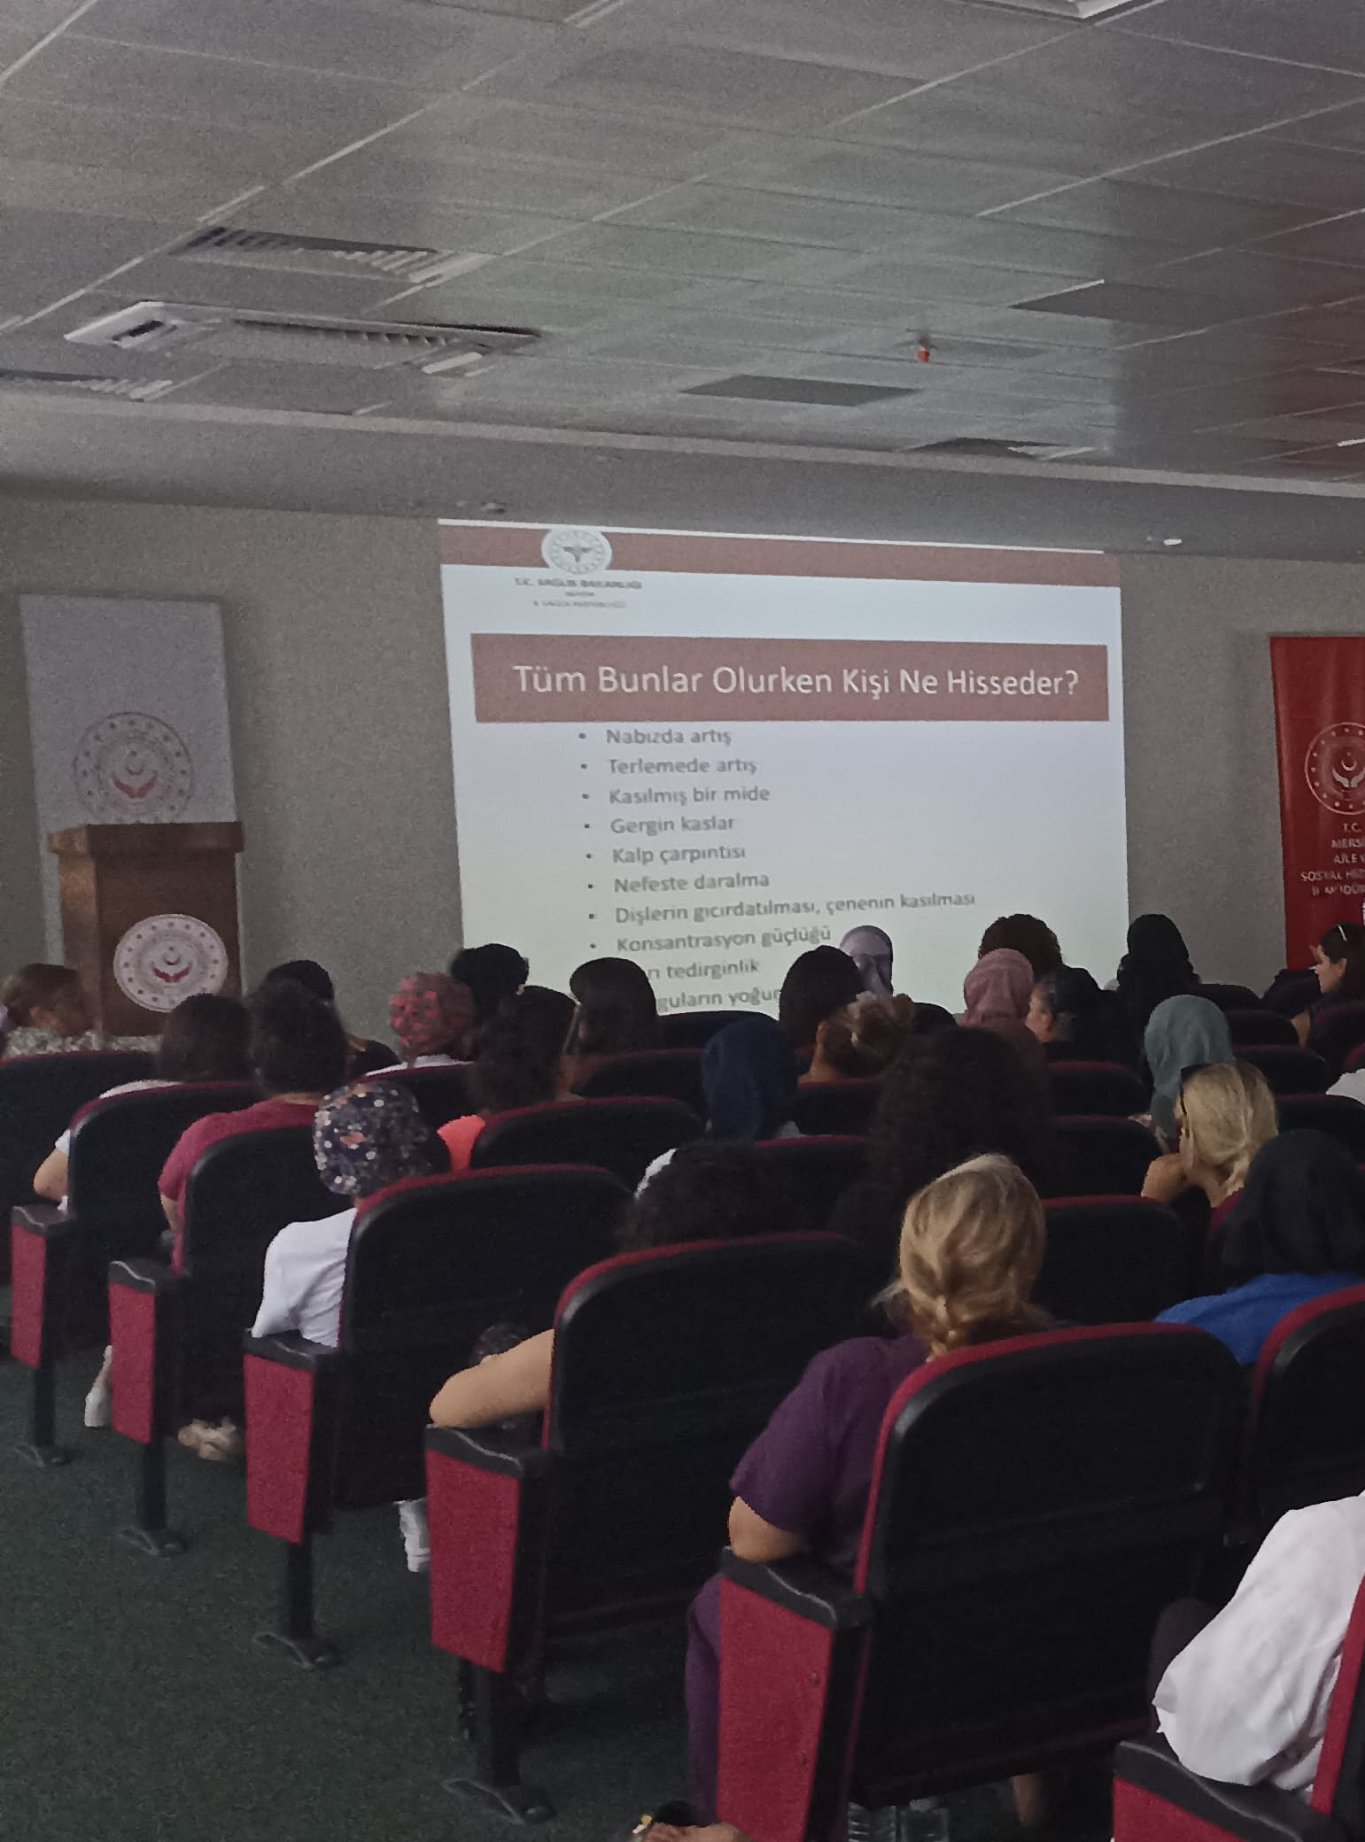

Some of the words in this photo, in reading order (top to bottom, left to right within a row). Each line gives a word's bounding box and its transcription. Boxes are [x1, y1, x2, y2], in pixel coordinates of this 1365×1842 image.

[513, 665, 586, 693] Tüm
[598, 665, 703, 693] Bunlar
[713, 665, 832, 694] Olurken
[843, 668, 890, 700] Kişi
[900, 669, 938, 694] Ne
[949, 669, 1079, 695] Hisseder?
[606, 728, 684, 745] Nabızda
[690, 728, 732, 747] artış
[609, 757, 710, 774] Terlemede
[716, 758, 758, 775] artış
[609, 788, 688, 806] Kasılmış
[692, 786, 717, 802] bir
[723, 785, 771, 801] mide
[610, 817, 675, 836] Gergin
[681, 815, 735, 832] kaslar
[612, 847, 654, 866] Kalp
[659, 845, 747, 865] çarpıntısı
[614, 876, 689, 893] Nefeste
[694, 872, 771, 890] daralma
[615, 906, 689, 926] Dişlerin
[693, 900, 821, 923] gıcırdatılması,
[826, 898, 895, 916] çenenin
[900, 893, 976, 909] kasılması
[617, 930, 756, 952] Konsantrasyon
[761, 927, 832, 947] güçlüğü
[667, 958, 760, 980] tedirginlik
[658, 990, 723, 1013] guların
